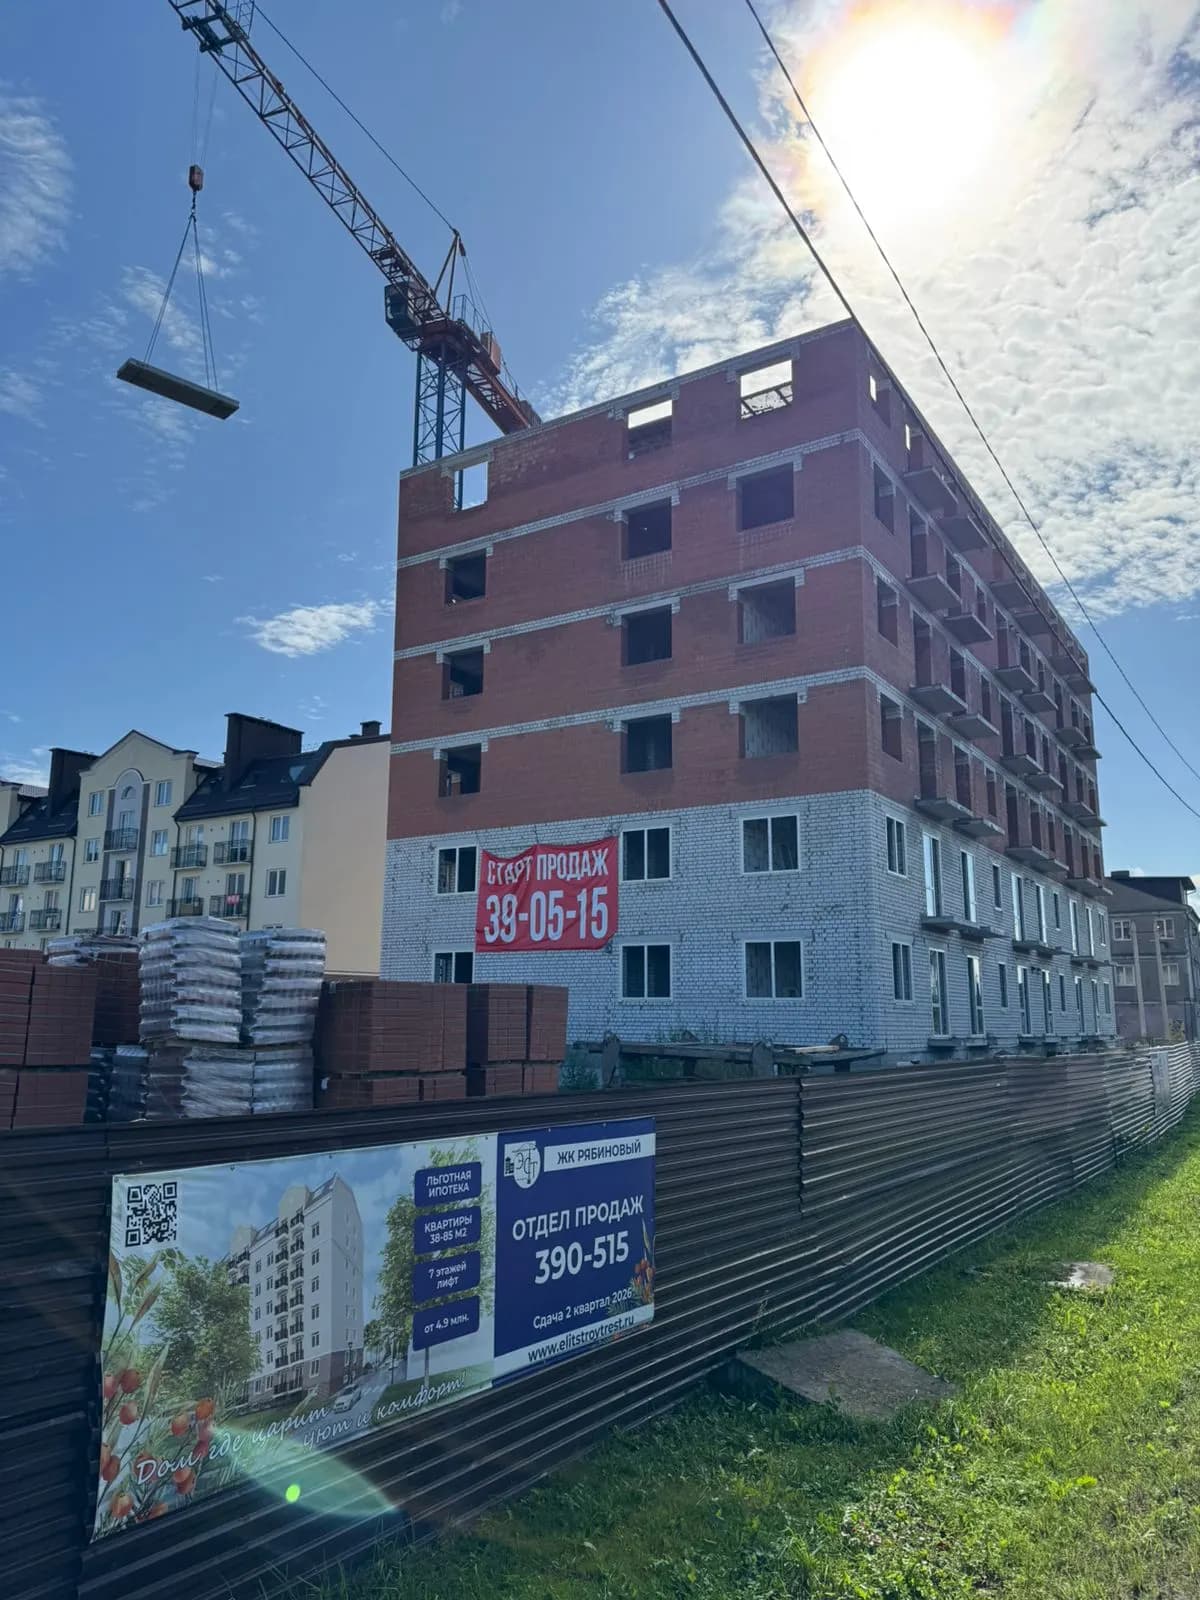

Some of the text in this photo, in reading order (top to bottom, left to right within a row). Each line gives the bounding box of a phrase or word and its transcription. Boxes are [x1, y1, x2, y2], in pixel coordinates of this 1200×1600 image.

[487, 848, 609, 885] СТАРТ ПРОДАЖ
[484, 886, 608, 943] 39-05-15
[557, 1139, 641, 1165] ЖК РЯБИНОВЫЙ
[426, 1170, 472, 1186] ЛЬГОТНАЯ
[428, 1182, 470, 1198] ИПОТЕКА
[424, 1214, 472, 1233] КВАРТИРЫ
[512, 1195, 644, 1241] ОТДЕЛ ПРОДАЖ
[429, 1229, 453, 1244] 38-85
[428, 1261, 467, 1279] 7 этажей
[534, 1230, 630, 1284] 390-515
[436, 1276, 459, 1289] лифт
[424, 1323, 435, 1334] от
[450, 1313, 470, 1327] млн.
[532, 1286, 633, 1330] Сдача 2 квартал 2026
[527, 1315, 635, 1363] www.elitstroytrest.ru
[303, 1370, 467, 1450] уют и комфорт!
[137, 1406, 330, 1485] Дом где царит
